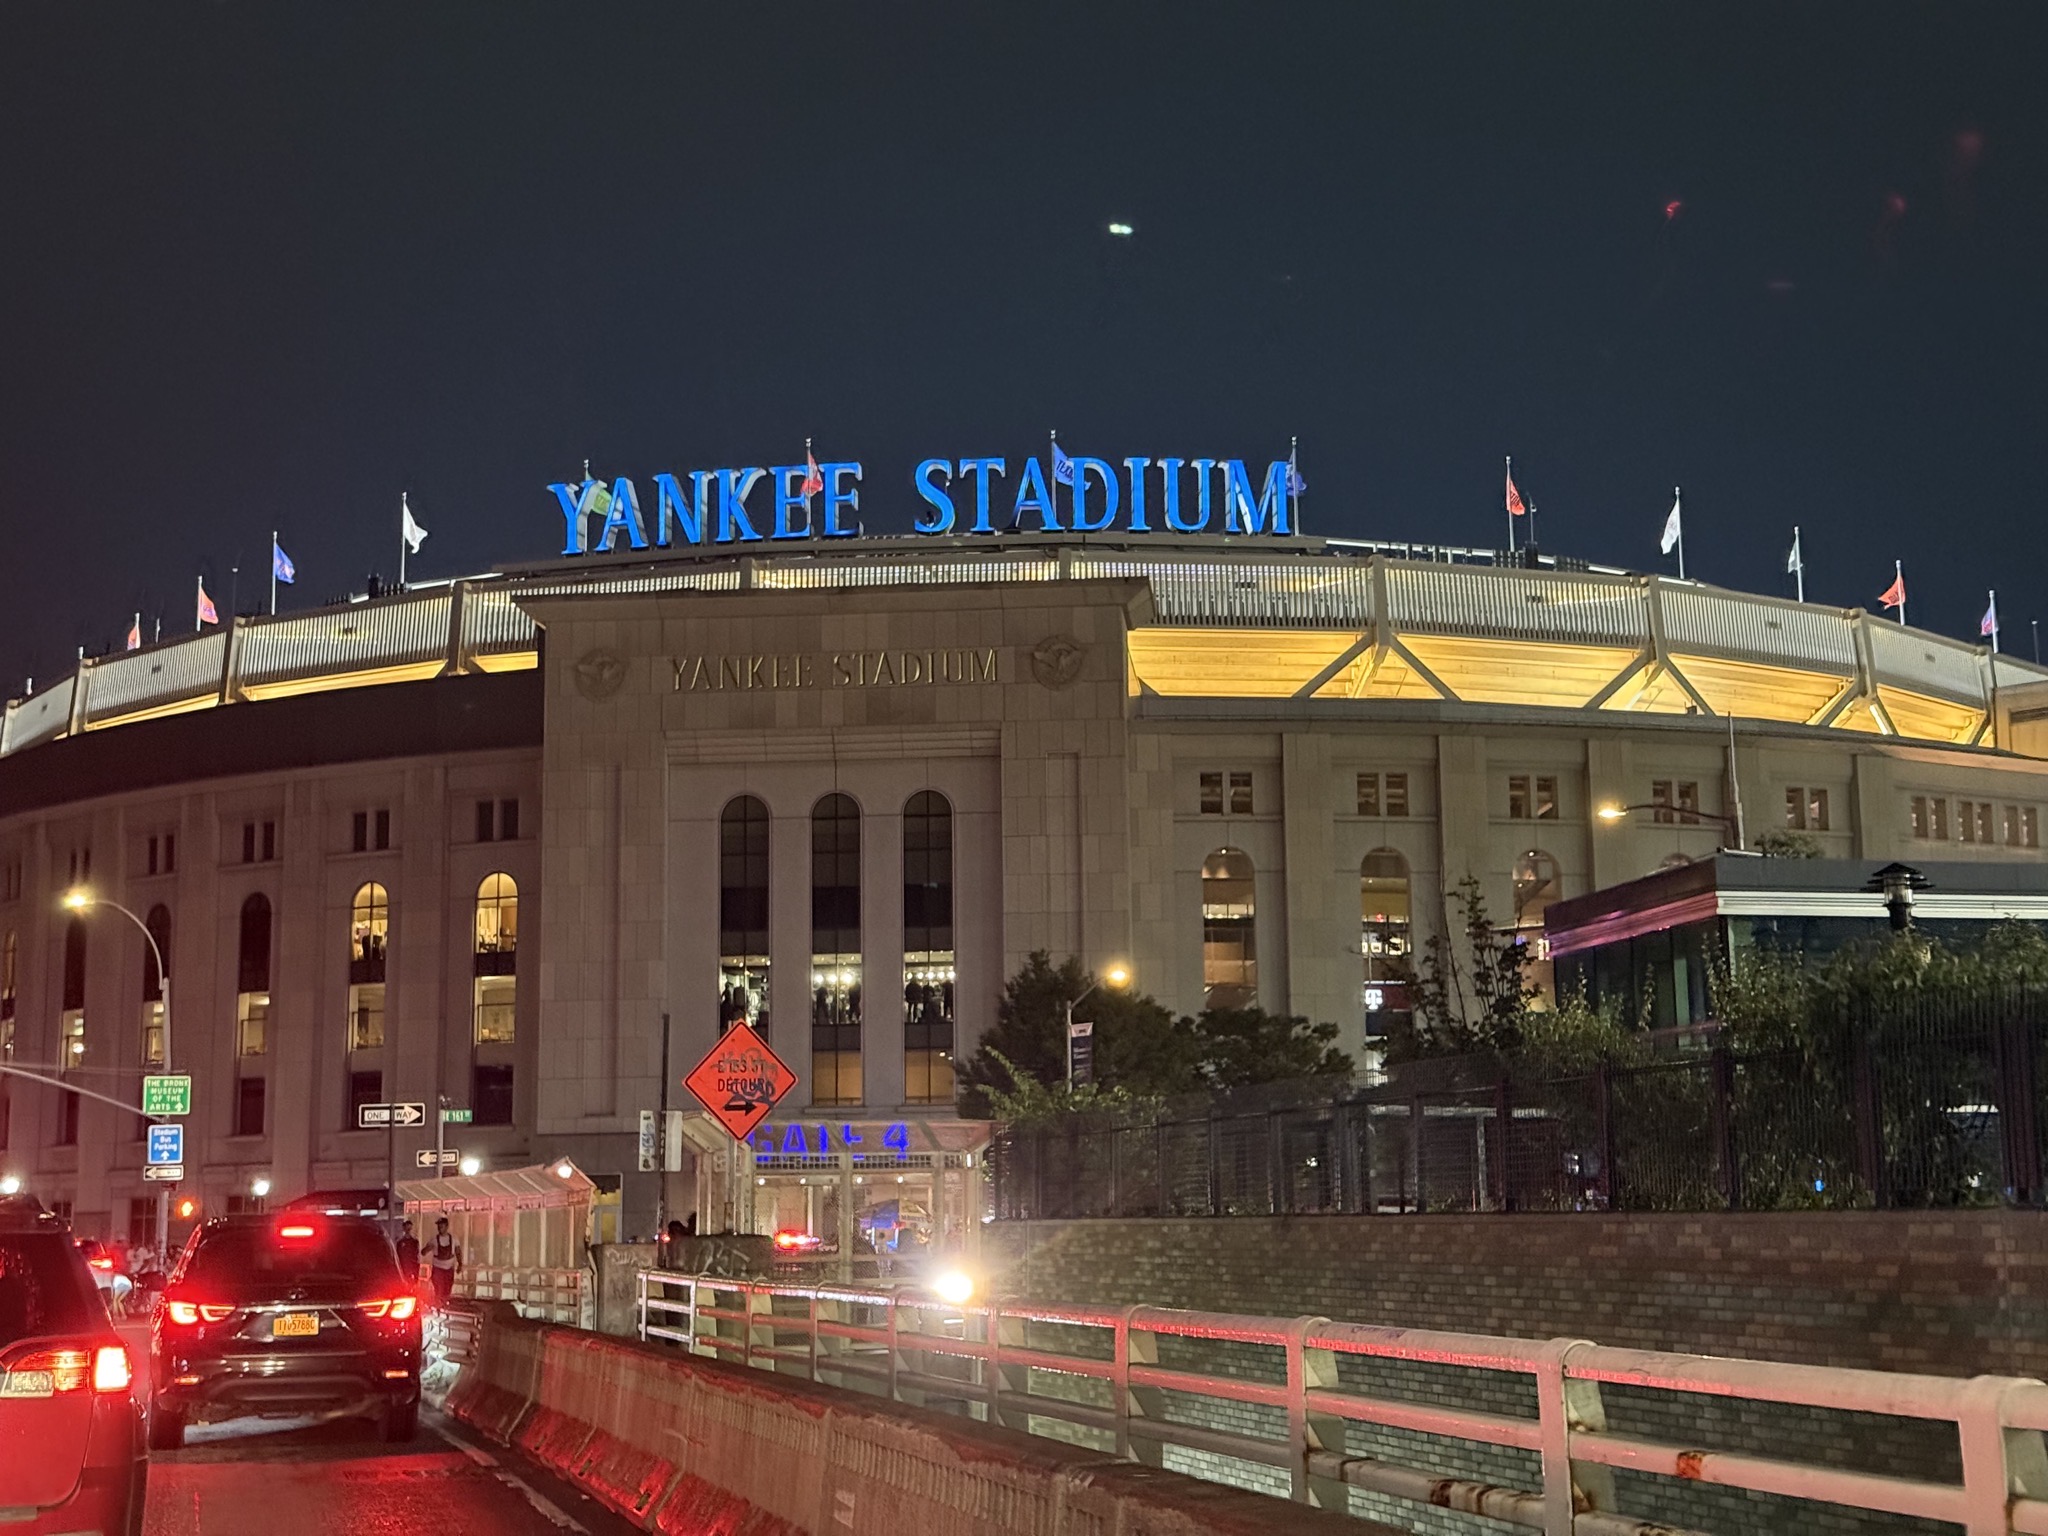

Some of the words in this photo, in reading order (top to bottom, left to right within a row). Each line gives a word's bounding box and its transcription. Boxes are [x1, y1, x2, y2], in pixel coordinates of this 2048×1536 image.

[546, 462, 864, 556] YANKEE
[913, 456, 1292, 536] STADIUM
[668, 654, 813, 691] YANKEE
[833, 648, 998, 687] STADIUM
[147, 1079, 161, 1087] THE
[717, 1078, 767, 1093] DETOUR
[150, 1087, 184, 1095] MUSEUM
[152, 1095, 163, 1103] OF
[149, 1103, 171, 1111] ARTS
[366, 1111, 385, 1120] ONE
[395, 1109, 414, 1119] WAY
[882, 1121, 910, 1160] 4
[153, 1143, 178, 1152] Parking
